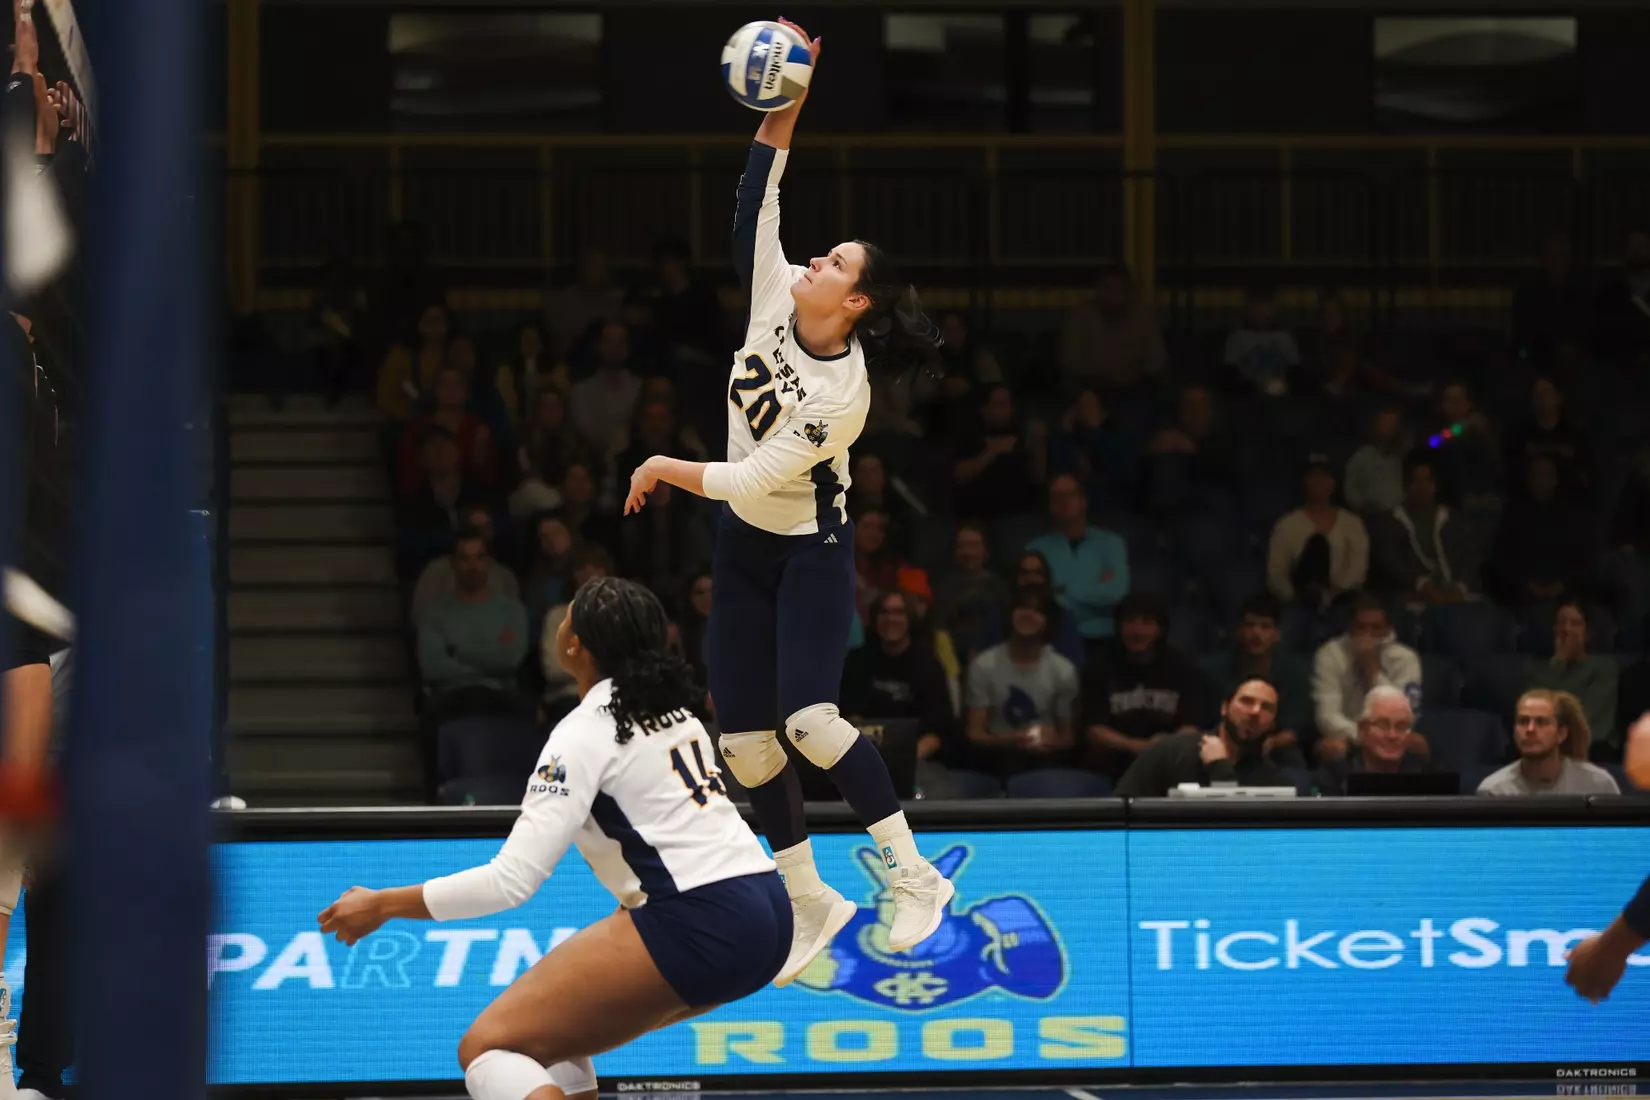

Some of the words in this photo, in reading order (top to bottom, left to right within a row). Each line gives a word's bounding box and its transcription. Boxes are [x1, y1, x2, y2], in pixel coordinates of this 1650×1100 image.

[764, 42, 783, 89] molten
[730, 353, 784, 442] 20
[639, 708, 696, 737] ROO
[530, 784, 571, 798] ROOS
[1139, 918, 1650, 970] TicketSm
[691, 1015, 1127, 1066] ROOS
[1556, 1067, 1637, 1078] DAKTRONICS
